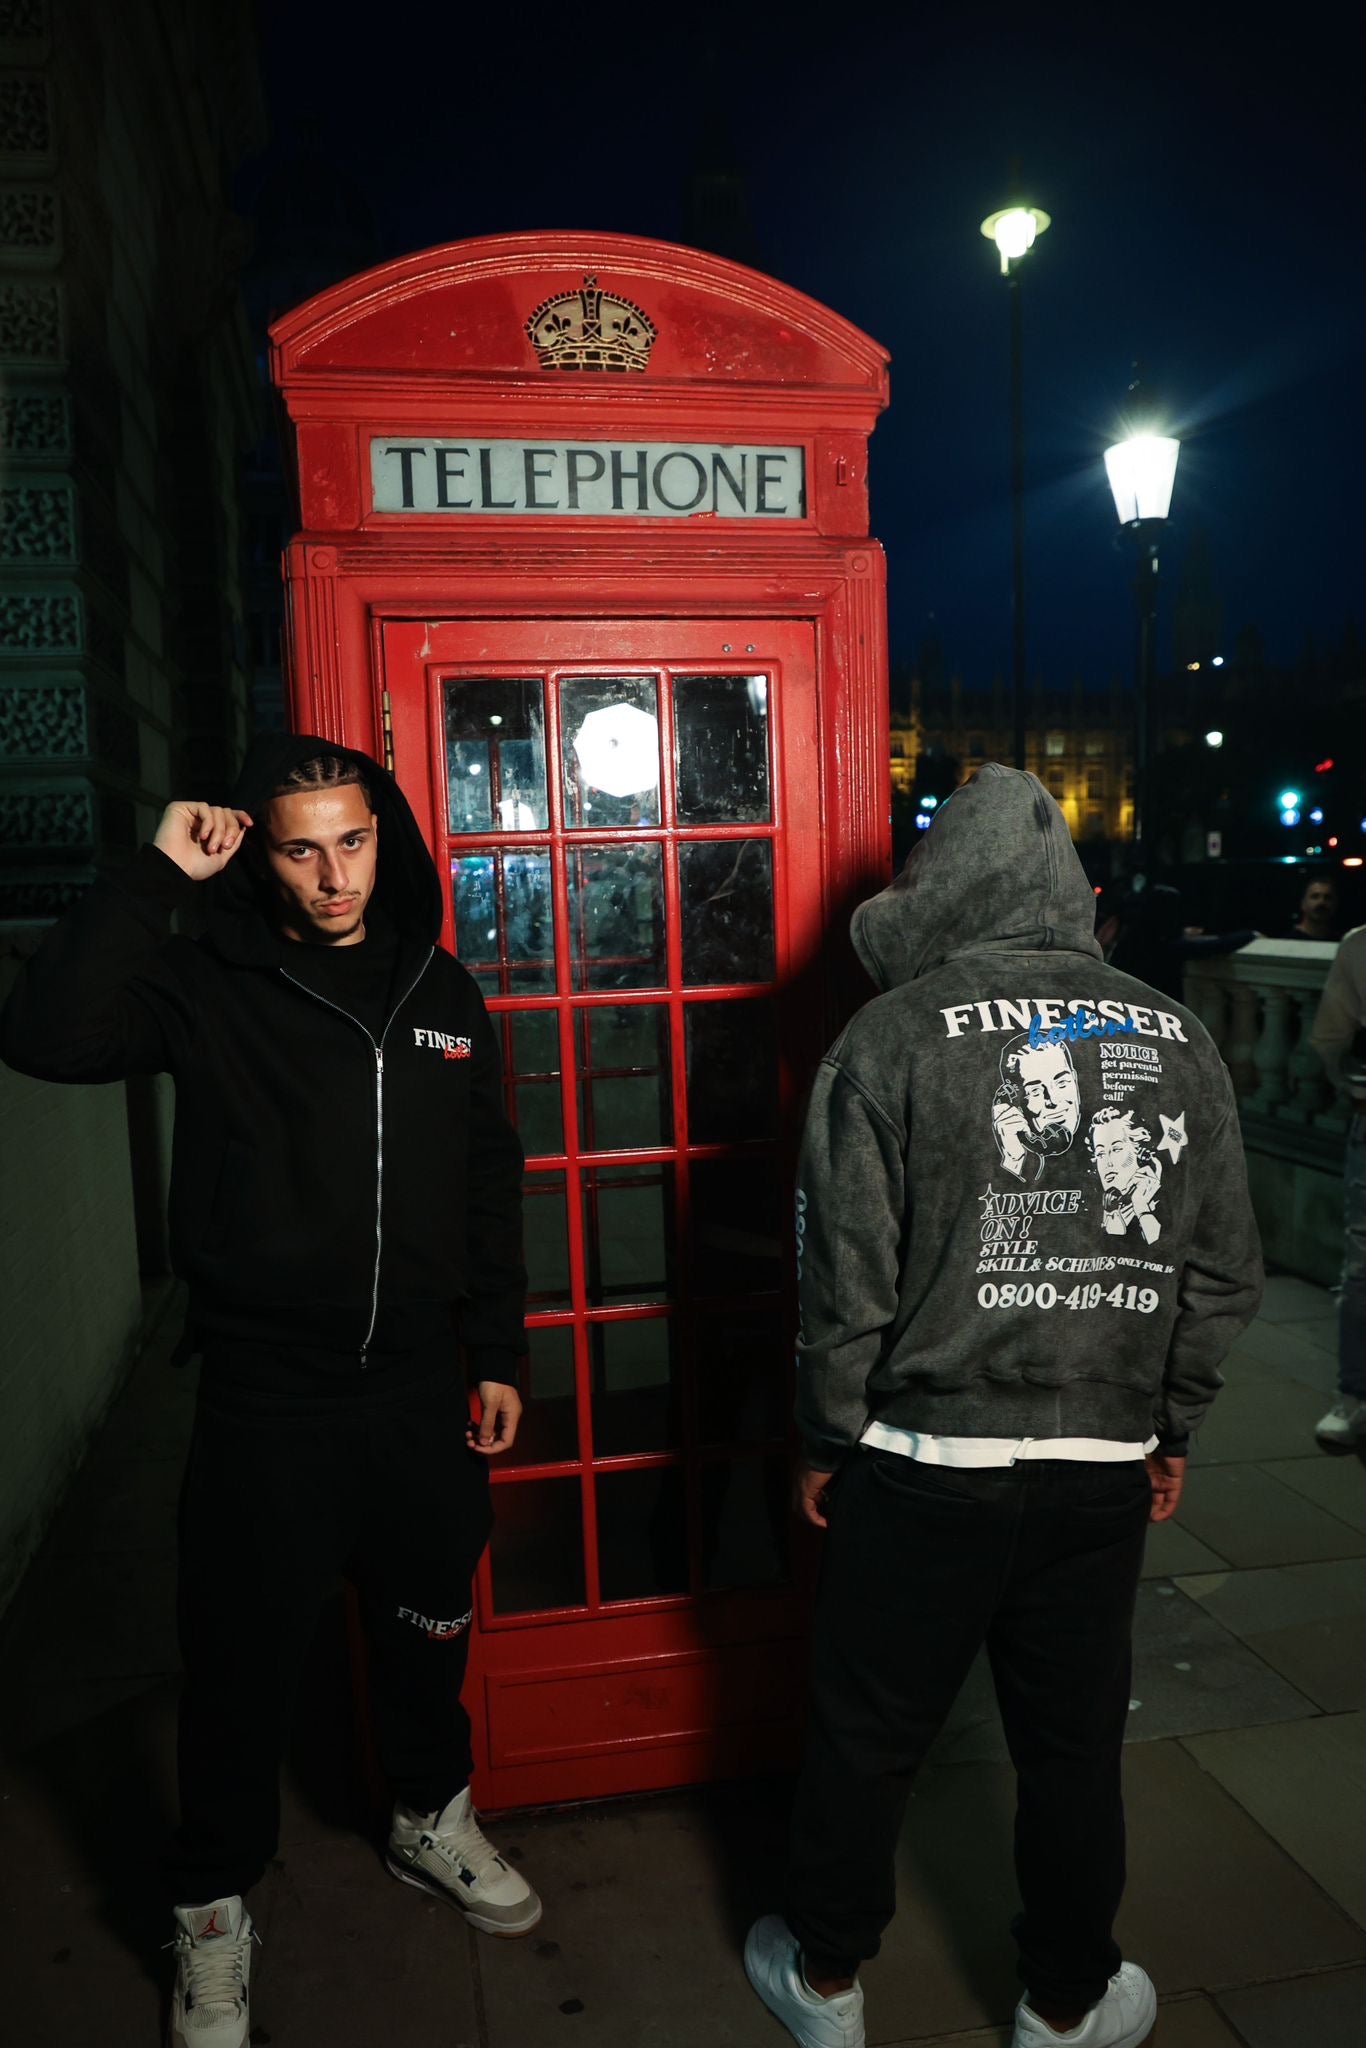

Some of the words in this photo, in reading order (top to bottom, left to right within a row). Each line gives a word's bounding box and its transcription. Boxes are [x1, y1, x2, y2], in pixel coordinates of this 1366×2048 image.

[384, 447, 788, 514] TELEPHONE
[939, 999, 1189, 1043] FINESSER
[1099, 1043, 1159, 1064] NOTICE
[1101, 1059, 1118, 1070] get
[1119, 1061, 1163, 1073] parental
[1102, 1070, 1159, 1084] permission
[1103, 1082, 1136, 1092] before
[1103, 1091, 1125, 1102] call!
[979, 1189, 1083, 1220] ADVICE
[979, 1240, 1039, 1258] STYLE
[1045, 1256, 1117, 1273] SCHEMES
[977, 1282, 1160, 1314] 0800-419-419
